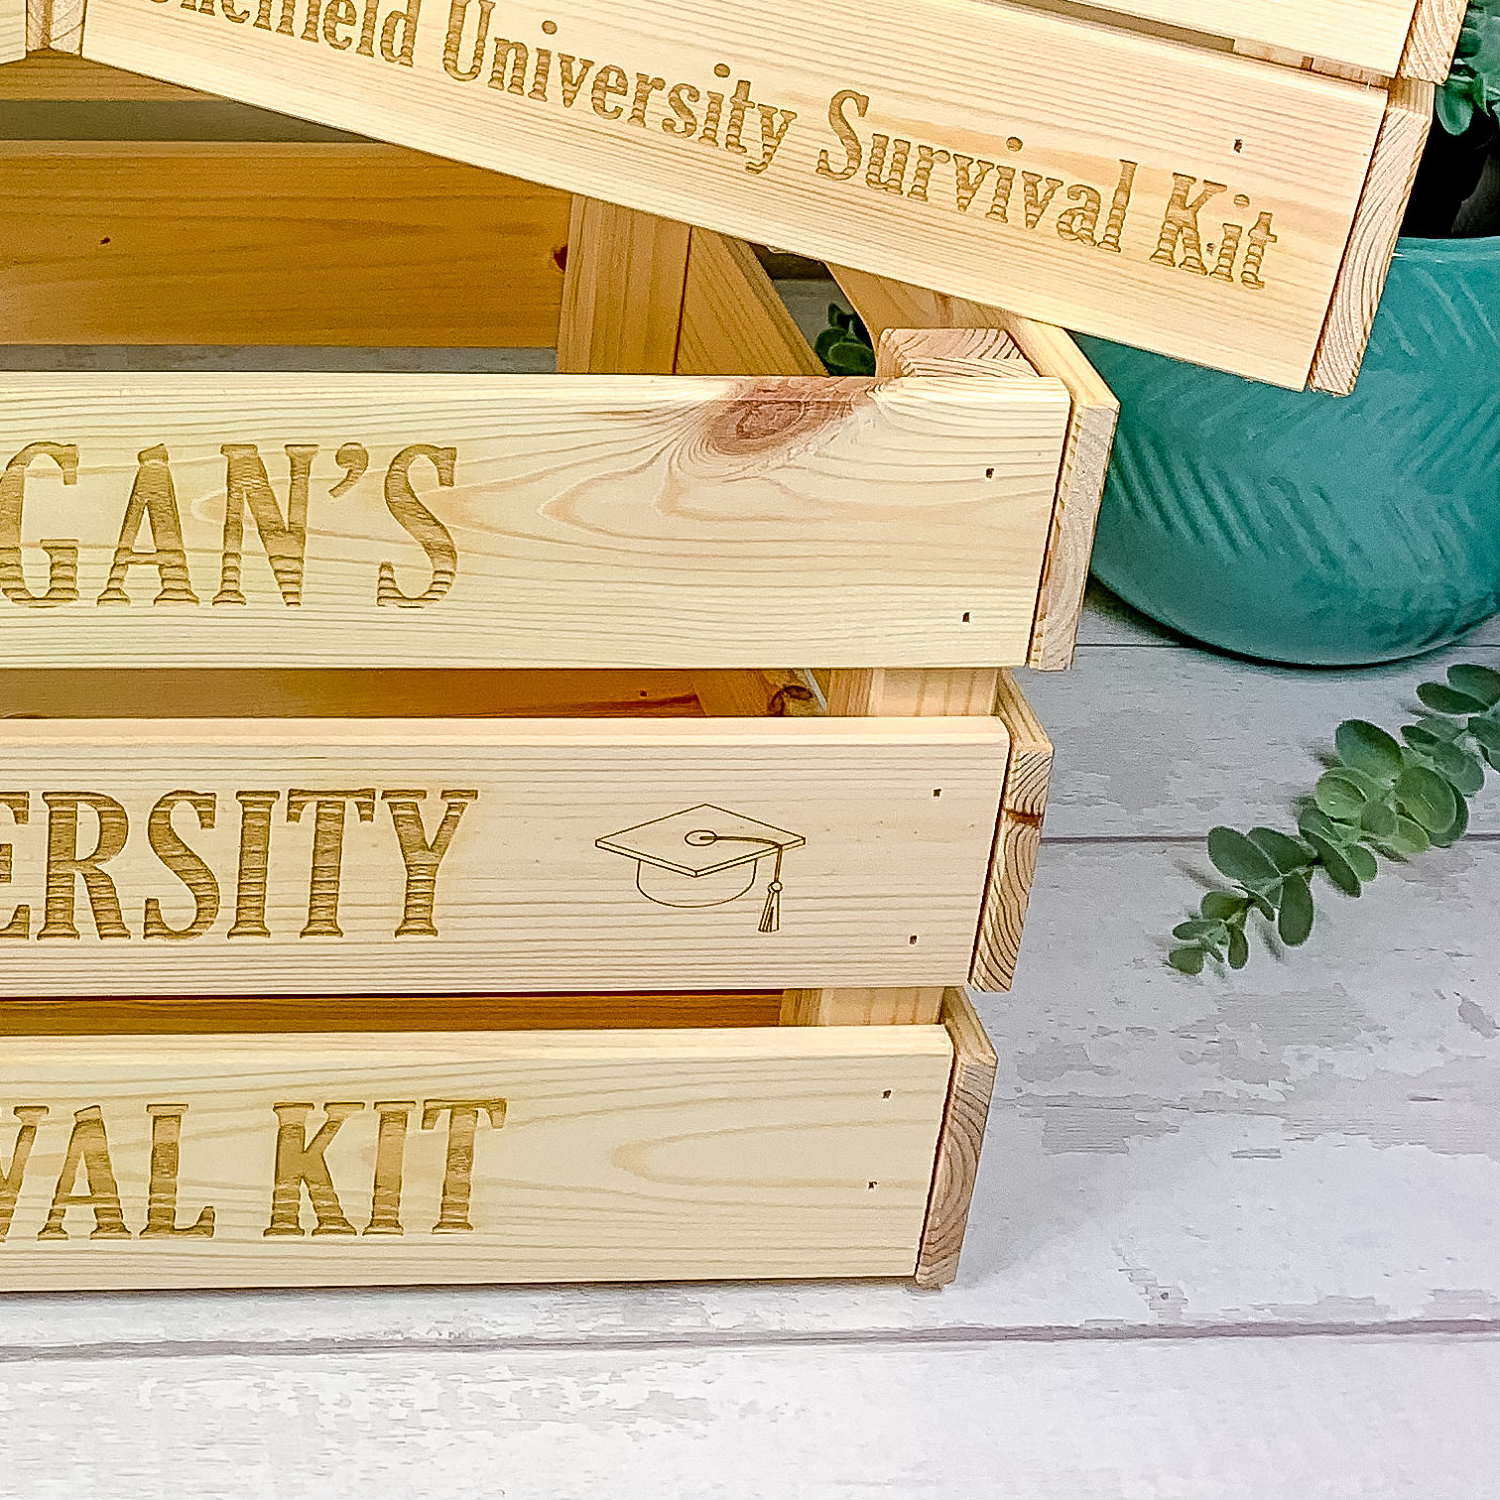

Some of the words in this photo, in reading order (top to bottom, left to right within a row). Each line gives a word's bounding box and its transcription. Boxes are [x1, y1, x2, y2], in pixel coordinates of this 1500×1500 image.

[816, 89, 1137, 252] Survival
[1150, 172, 1279, 290] Kit
[261, 1098, 507, 1238] KIT
